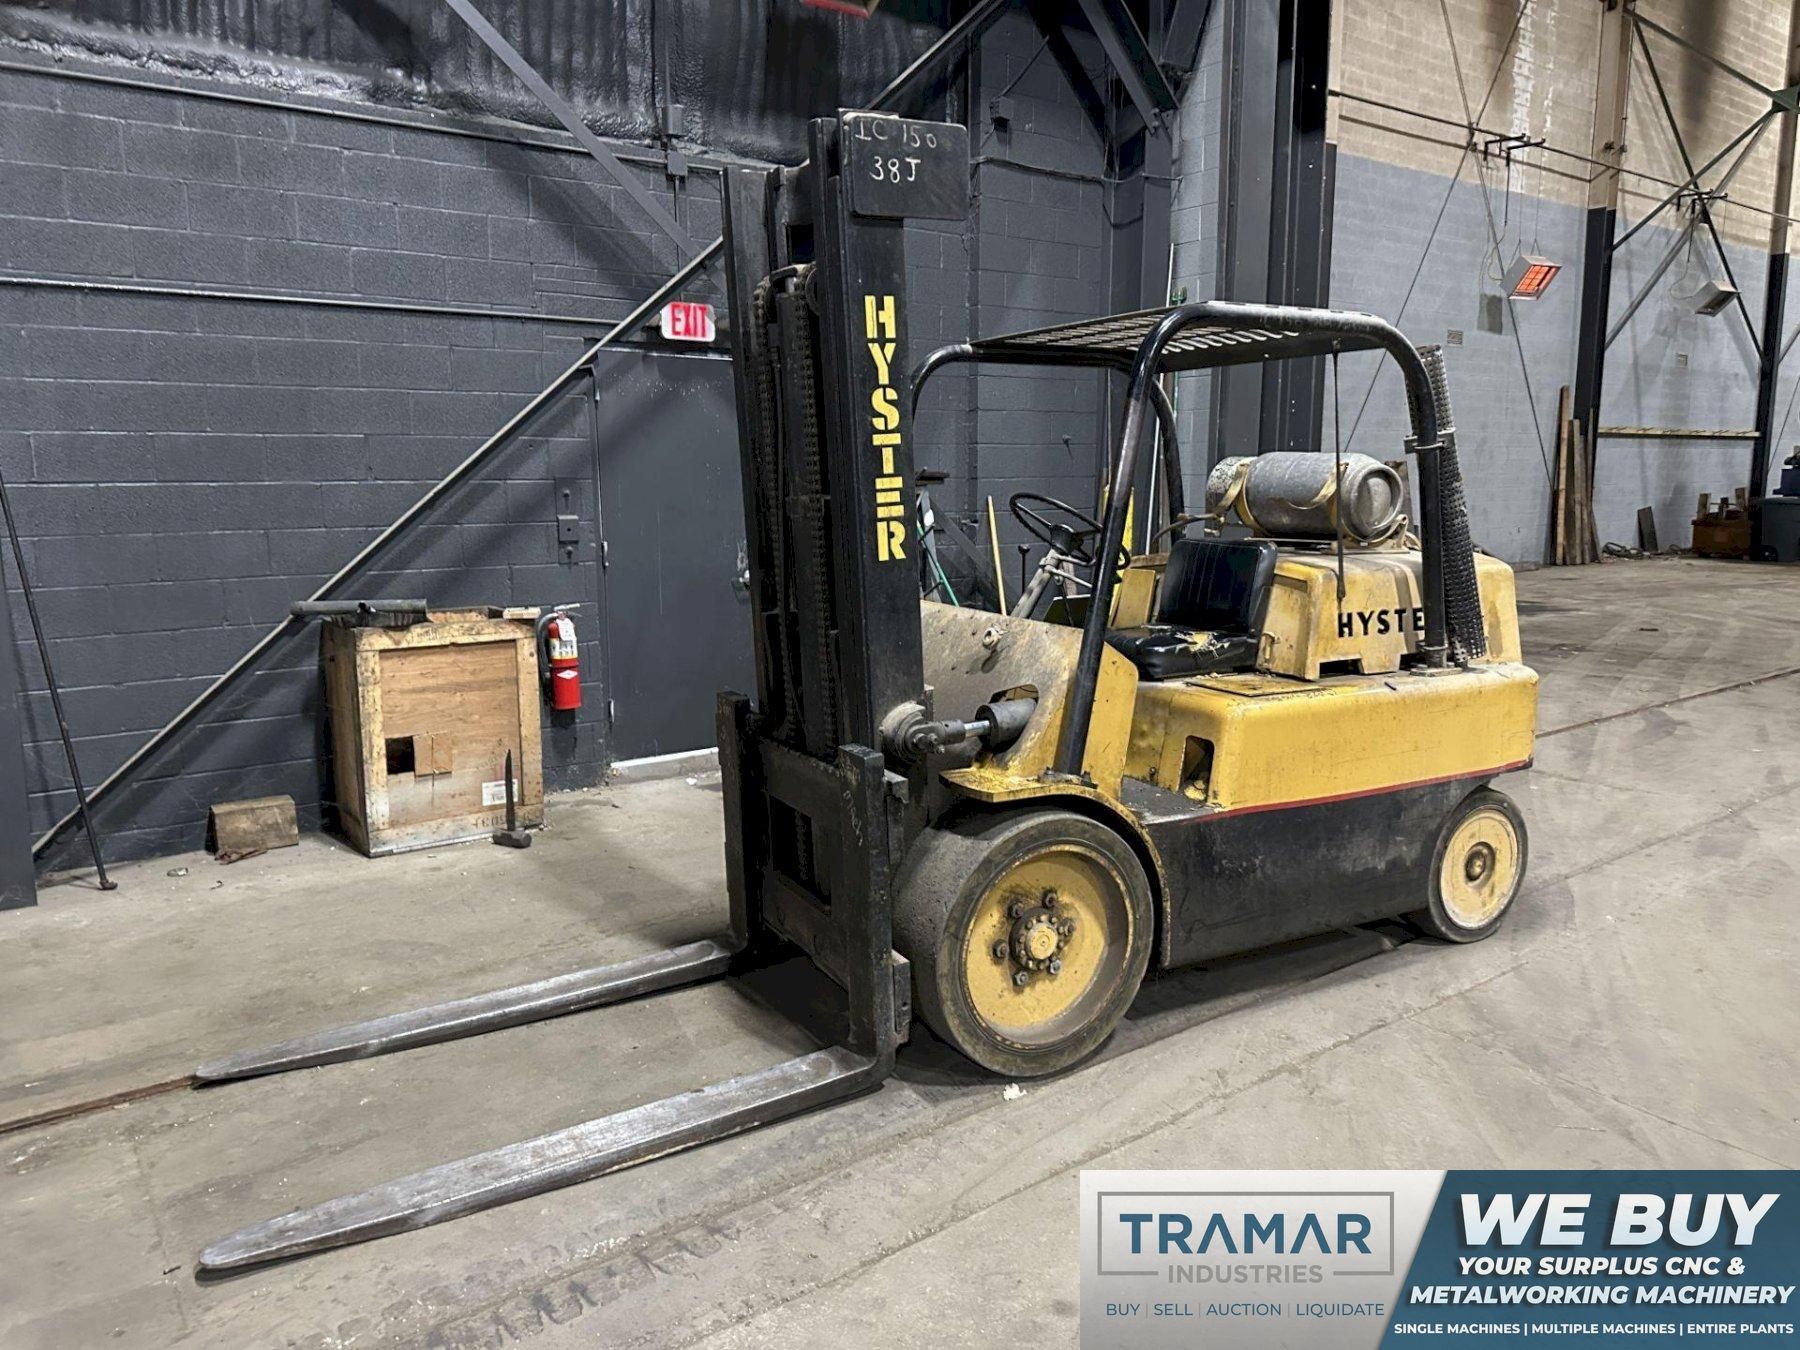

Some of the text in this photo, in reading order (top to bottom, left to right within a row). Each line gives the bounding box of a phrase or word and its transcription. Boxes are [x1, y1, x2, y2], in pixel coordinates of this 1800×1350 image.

[903, 122, 937, 148] 150
[870, 156, 921, 183] 38J
[671, 302, 708, 338] EXIT
[864, 295, 907, 562] HYSTER
[1337, 606, 1425, 638] HYSTE
